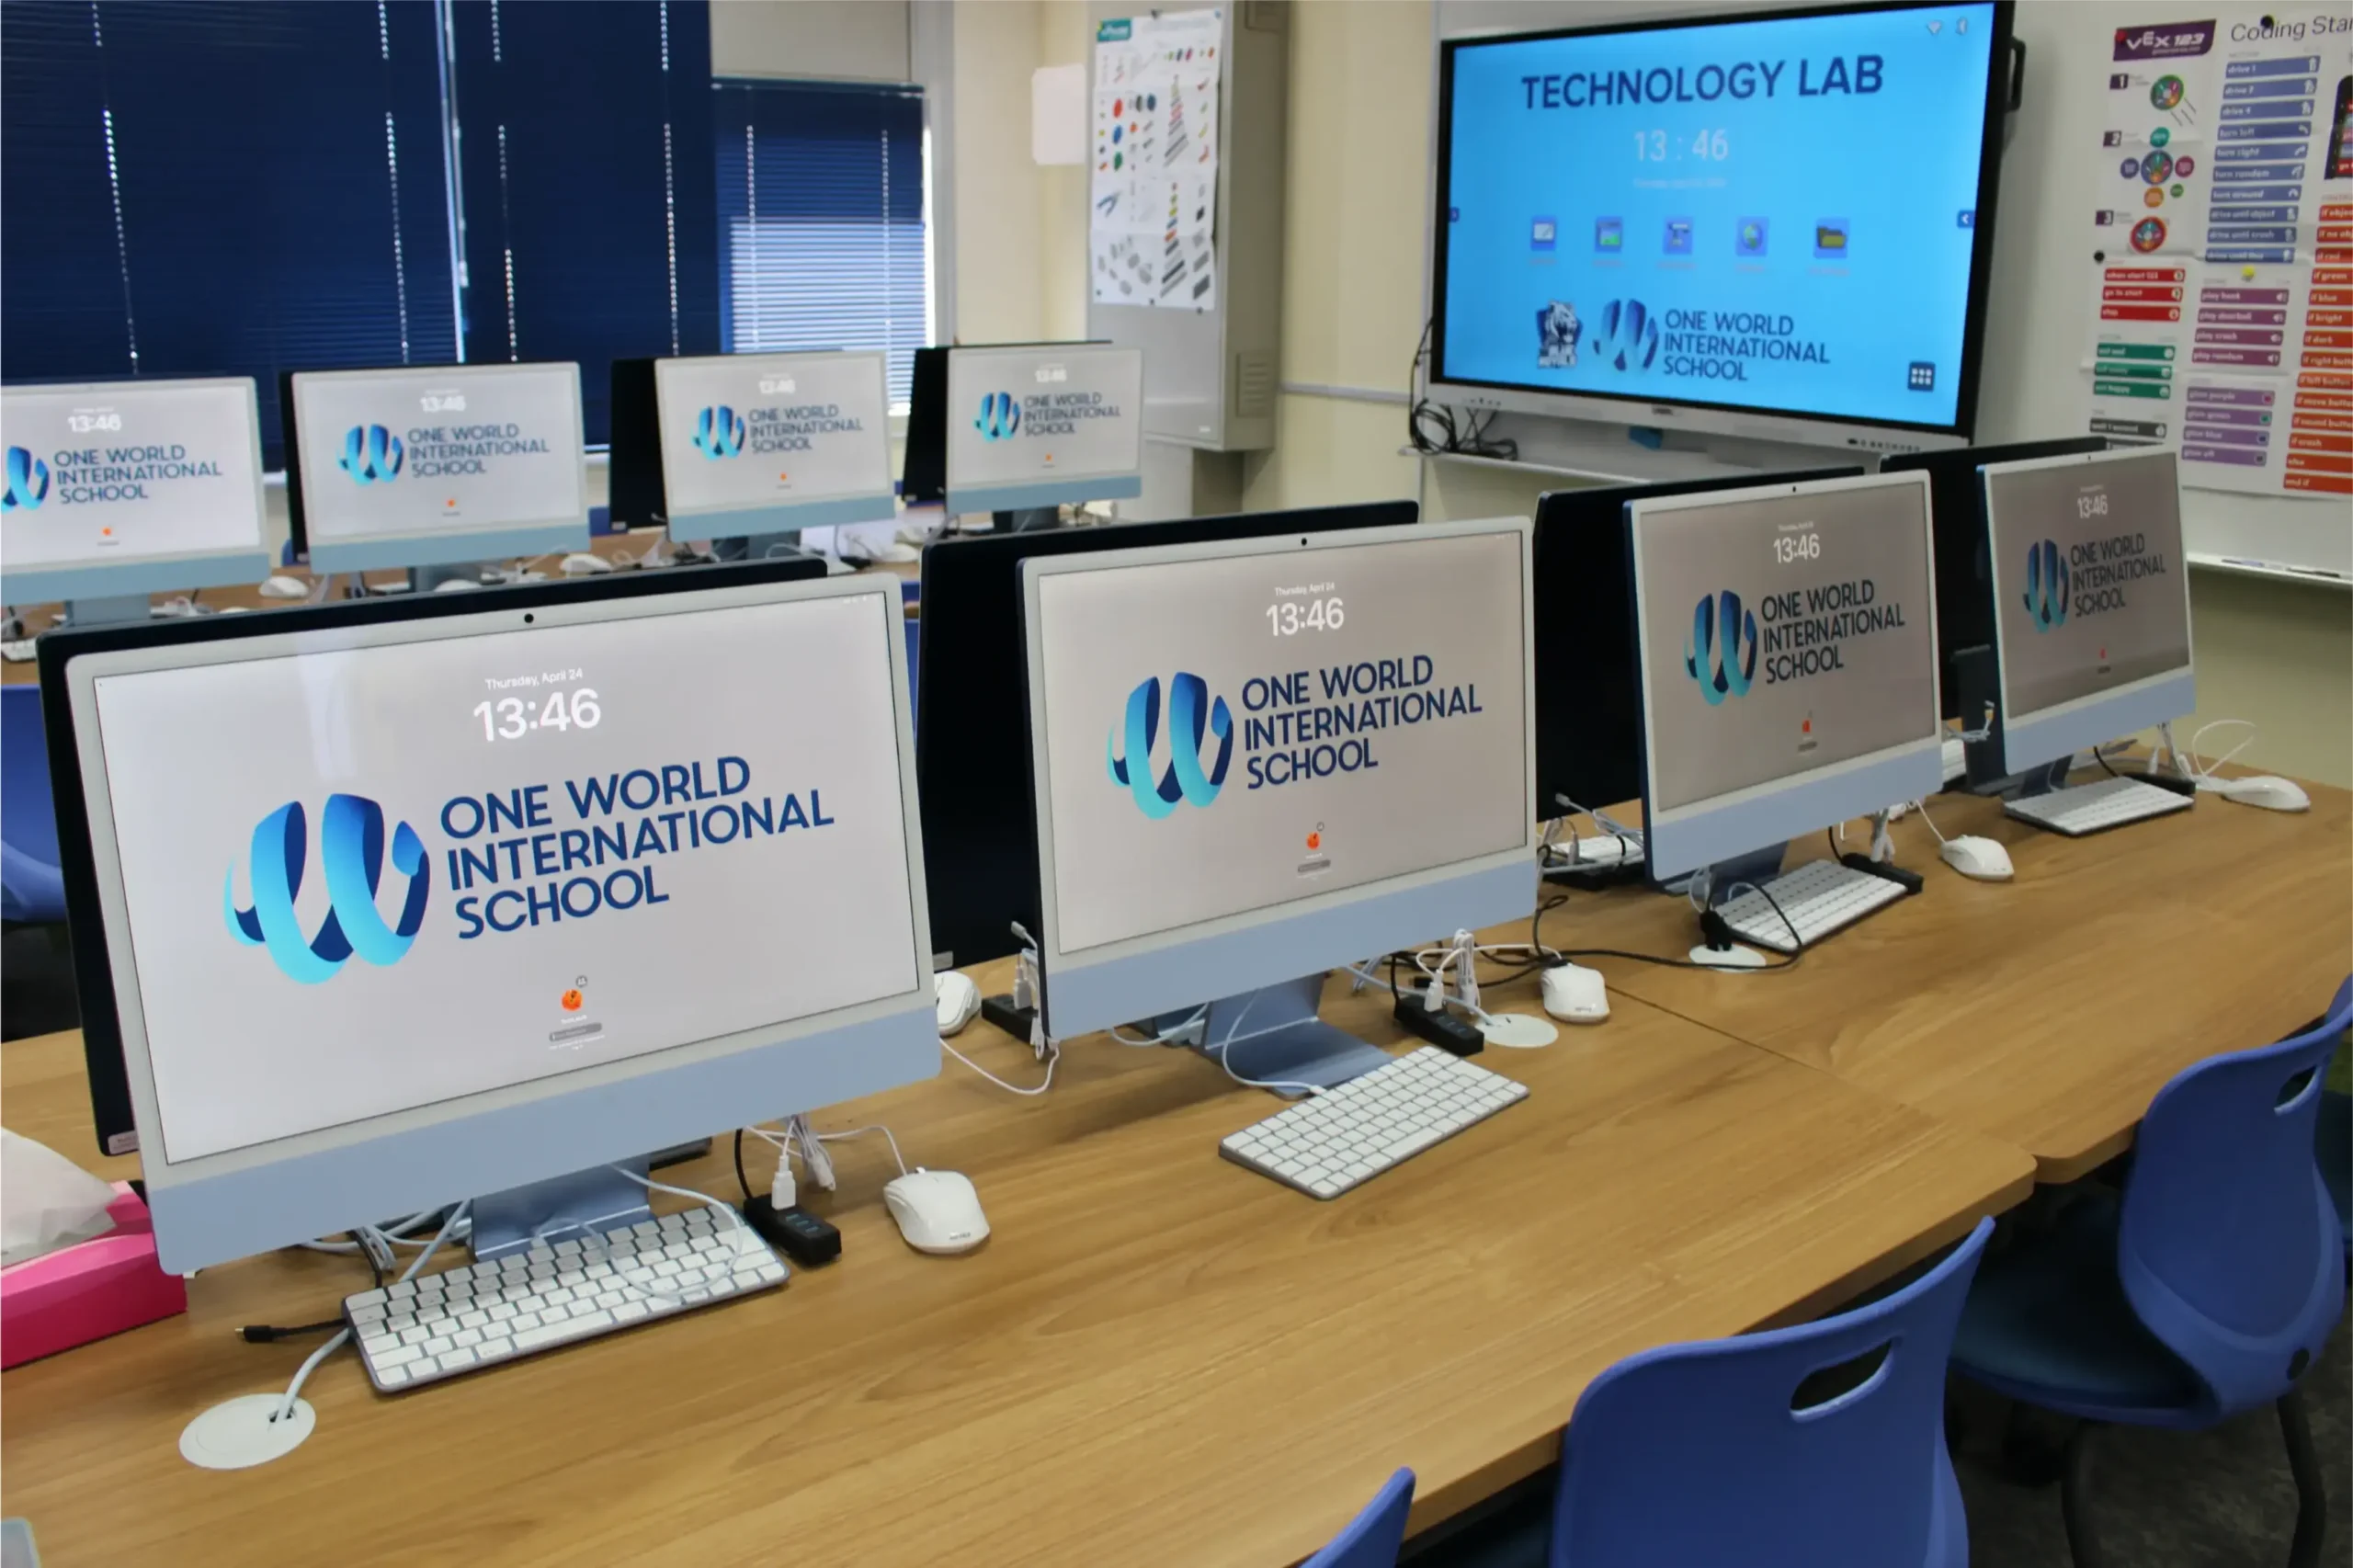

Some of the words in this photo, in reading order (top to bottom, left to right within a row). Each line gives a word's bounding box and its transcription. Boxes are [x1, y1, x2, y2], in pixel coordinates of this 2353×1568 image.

[2174, 32, 2205, 46] 123
[2231, 18, 2306, 41] Coding
[1521, 60, 1786, 109] TECHNOLOGY
[1799, 54, 1883, 96] LAB
[1665, 309, 1708, 331] ONE
[1715, 312, 1794, 336] WORLD
[1664, 334, 1831, 364] INTERNATIONAL
[1663, 357, 1748, 381] SCHOOL
[1023, 394, 1051, 408] ONE
[1053, 392, 1102, 405] WORLD
[67, 413, 122, 433] 13:46
[748, 408, 779, 423] ONE
[783, 404, 839, 419] WORLD
[1024, 406, 1121, 423] INTERNATIONAL
[407, 426, 445, 443] ONE
[450, 423, 519, 440] WORLD
[750, 418, 863, 438] INTERNATIONAL
[1025, 422, 1075, 437] SCHOOL
[54, 449, 99, 467] ONE
[106, 445, 186, 463] WORLD
[409, 438, 551, 460] INTERNATIONAL
[751, 437, 813, 453] SCHOOL
[57, 461, 222, 485] INTERNATIONAL
[412, 459, 486, 478] SCHOOL
[60, 484, 149, 504] SCHOOL
[2076, 494, 2109, 518] 13:46
[1773, 533, 1820, 563] 13:46
[2070, 541, 2097, 567] ONE
[2099, 533, 2144, 561] WORLD
[2072, 554, 2166, 593] INTERNATIONAL
[1761, 591, 1802, 622] ONE
[1806, 579, 1874, 614] WORLD
[2075, 586, 2126, 618] SCHOOL
[1267, 597, 1344, 636] 13:46
[1763, 603, 1905, 653] INTERNATIONAL
[1766, 644, 1844, 684] SCHOOL
[485, 676, 540, 690] Thursday,
[542, 669, 566, 684] April
[569, 667, 583, 680] 24
[1242, 671, 1310, 711] ONE
[1320, 654, 1433, 699] WORLD
[473, 687, 601, 742] 13:46
[1245, 684, 1483, 751] INTERNATIONAL
[1247, 738, 1378, 790] SCHOOL
[440, 784, 552, 839] ONE
[565, 756, 751, 819] WORLD
[448, 790, 834, 891] INTERNATIONAL
[455, 866, 669, 938] SCHOOL
